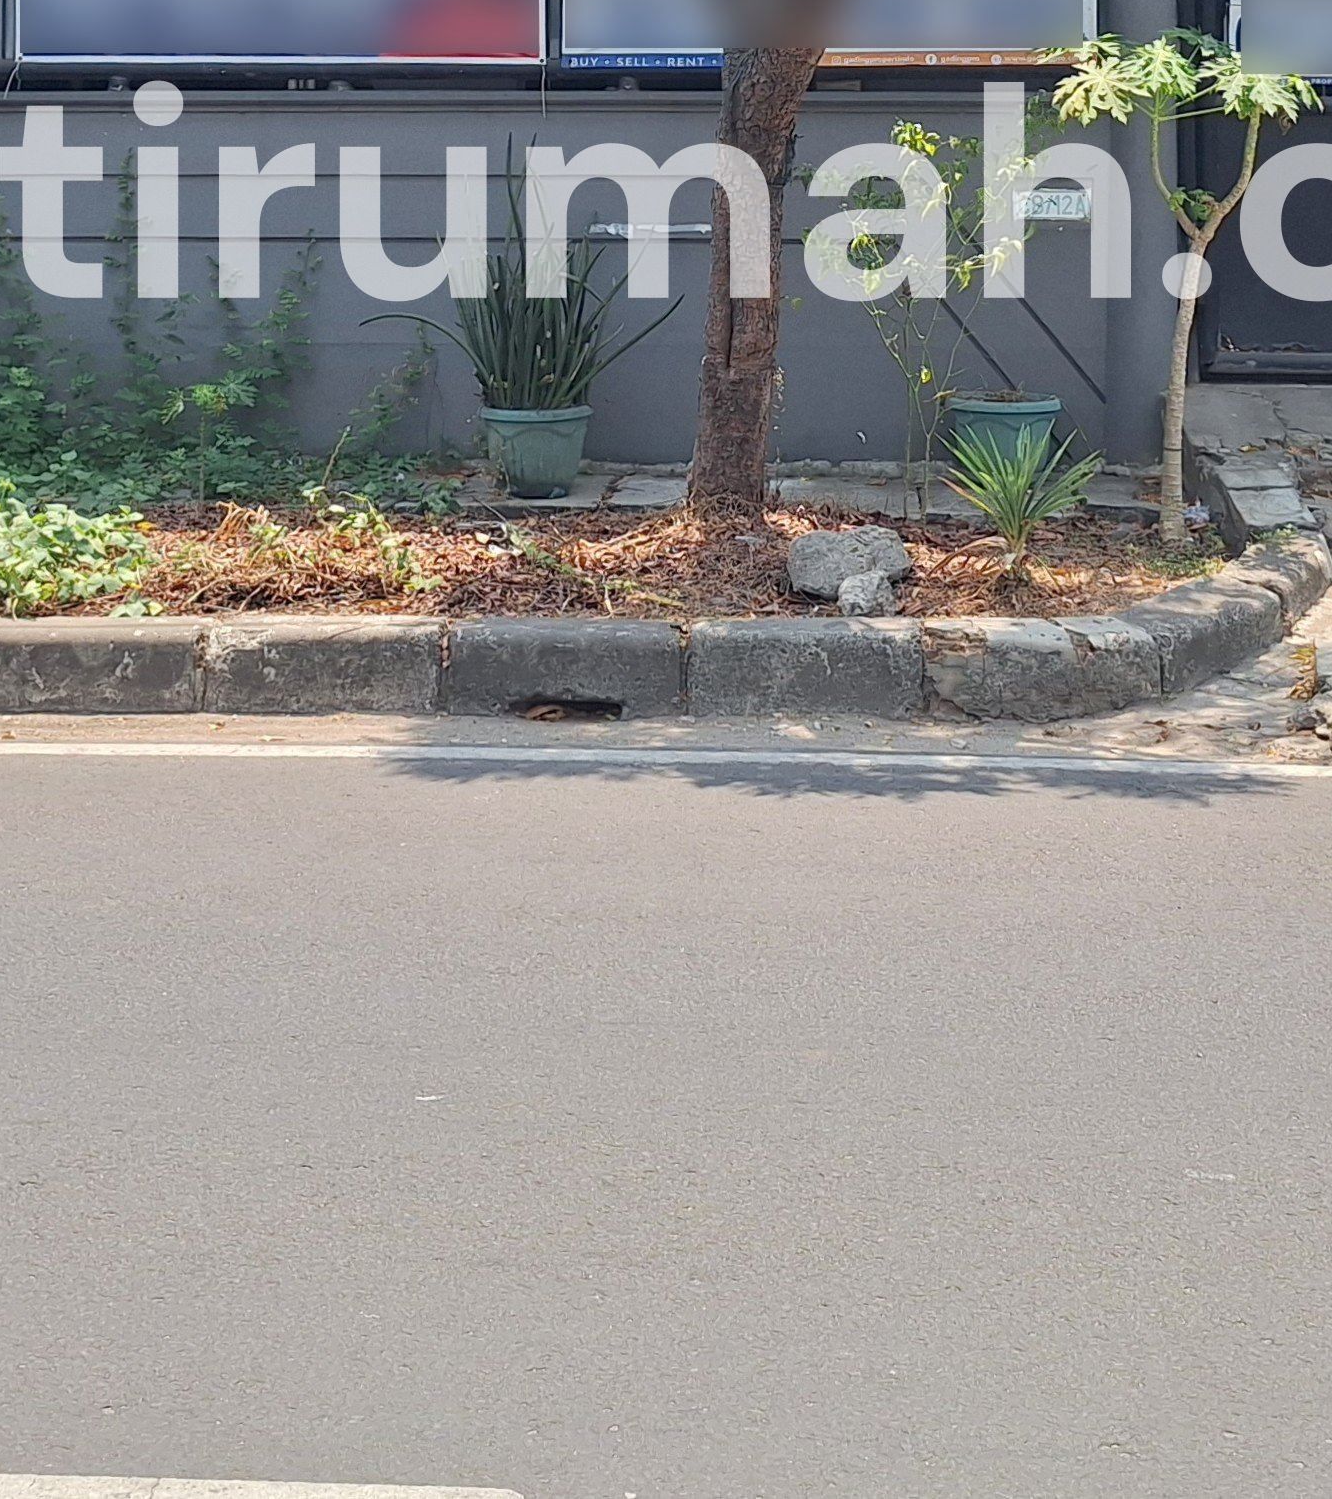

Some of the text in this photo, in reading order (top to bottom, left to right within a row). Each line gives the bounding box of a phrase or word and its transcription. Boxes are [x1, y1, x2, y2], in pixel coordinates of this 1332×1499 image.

[570, 56, 705, 67] BUY SELL RENT
